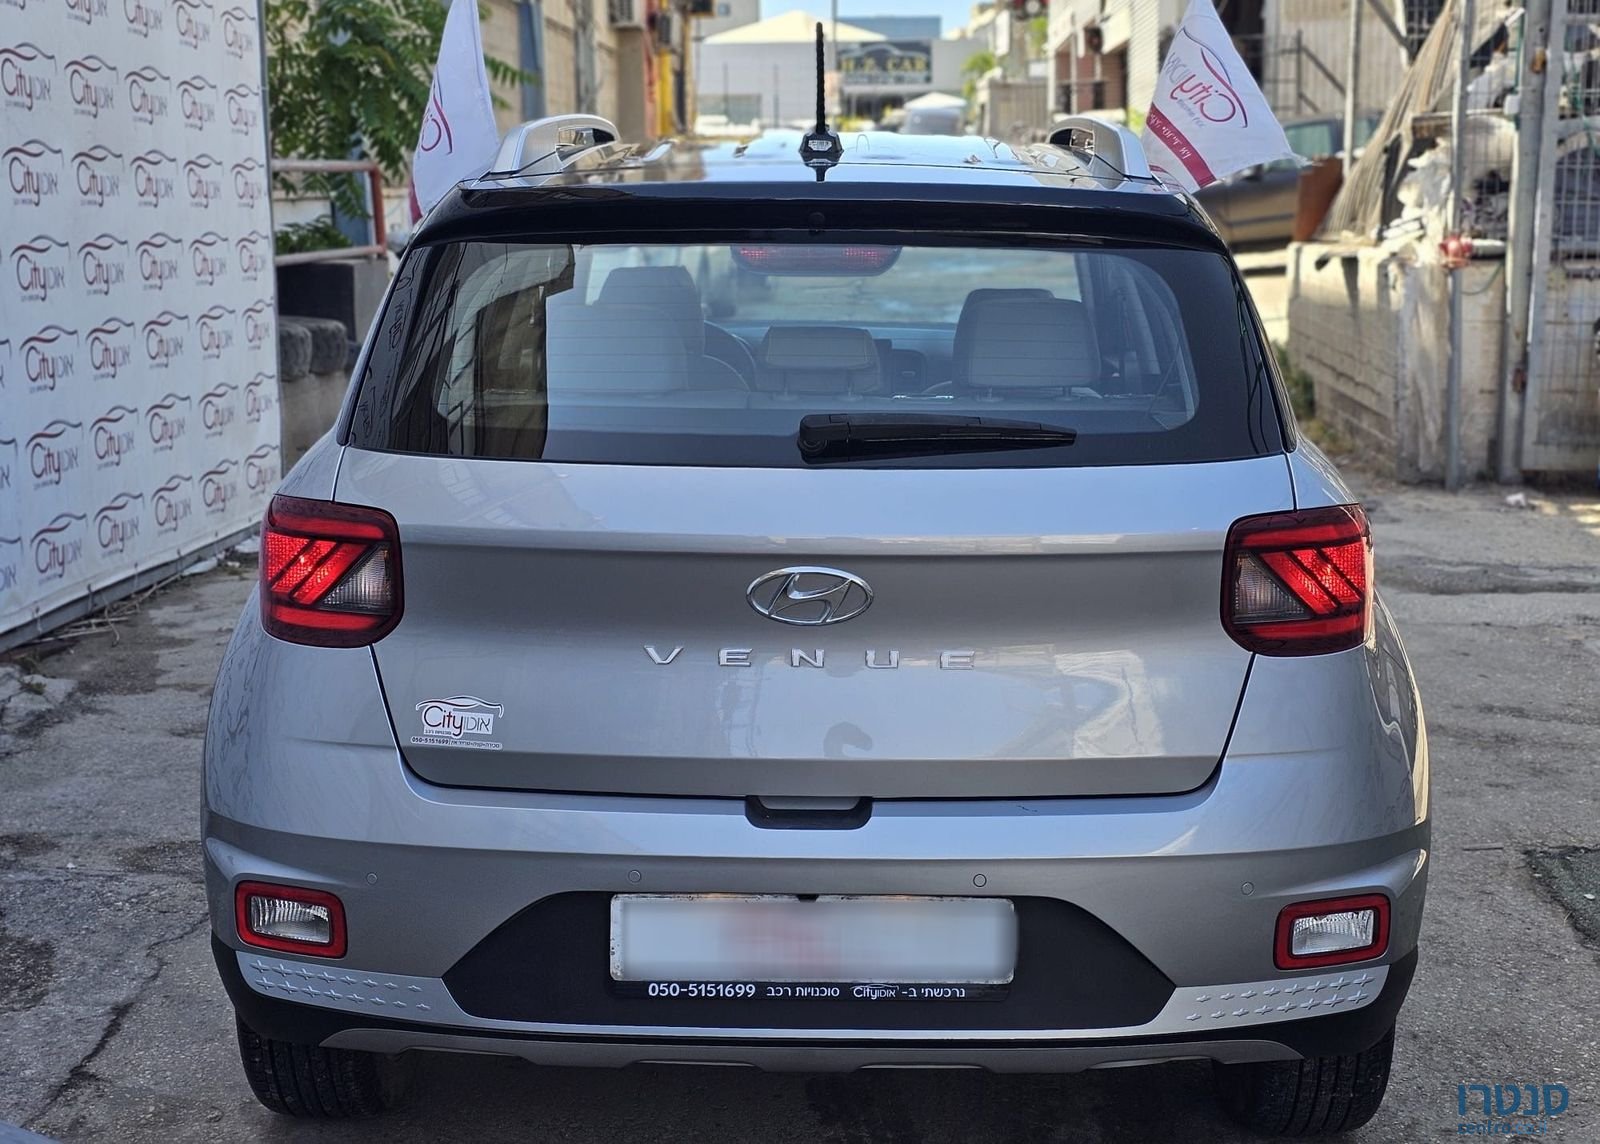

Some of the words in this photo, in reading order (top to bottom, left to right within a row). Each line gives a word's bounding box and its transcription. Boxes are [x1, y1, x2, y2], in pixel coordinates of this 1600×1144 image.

[644, 645, 976, 669] VENUE
[424, 705, 463, 737] City
[647, 983, 756, 997] 050-5151699
[766, 986, 791, 997] רכב
[795, 987, 840, 997] סוכנויות
[853, 987, 878, 1000] City
[921, 988, 966, 998] נרכשתי
